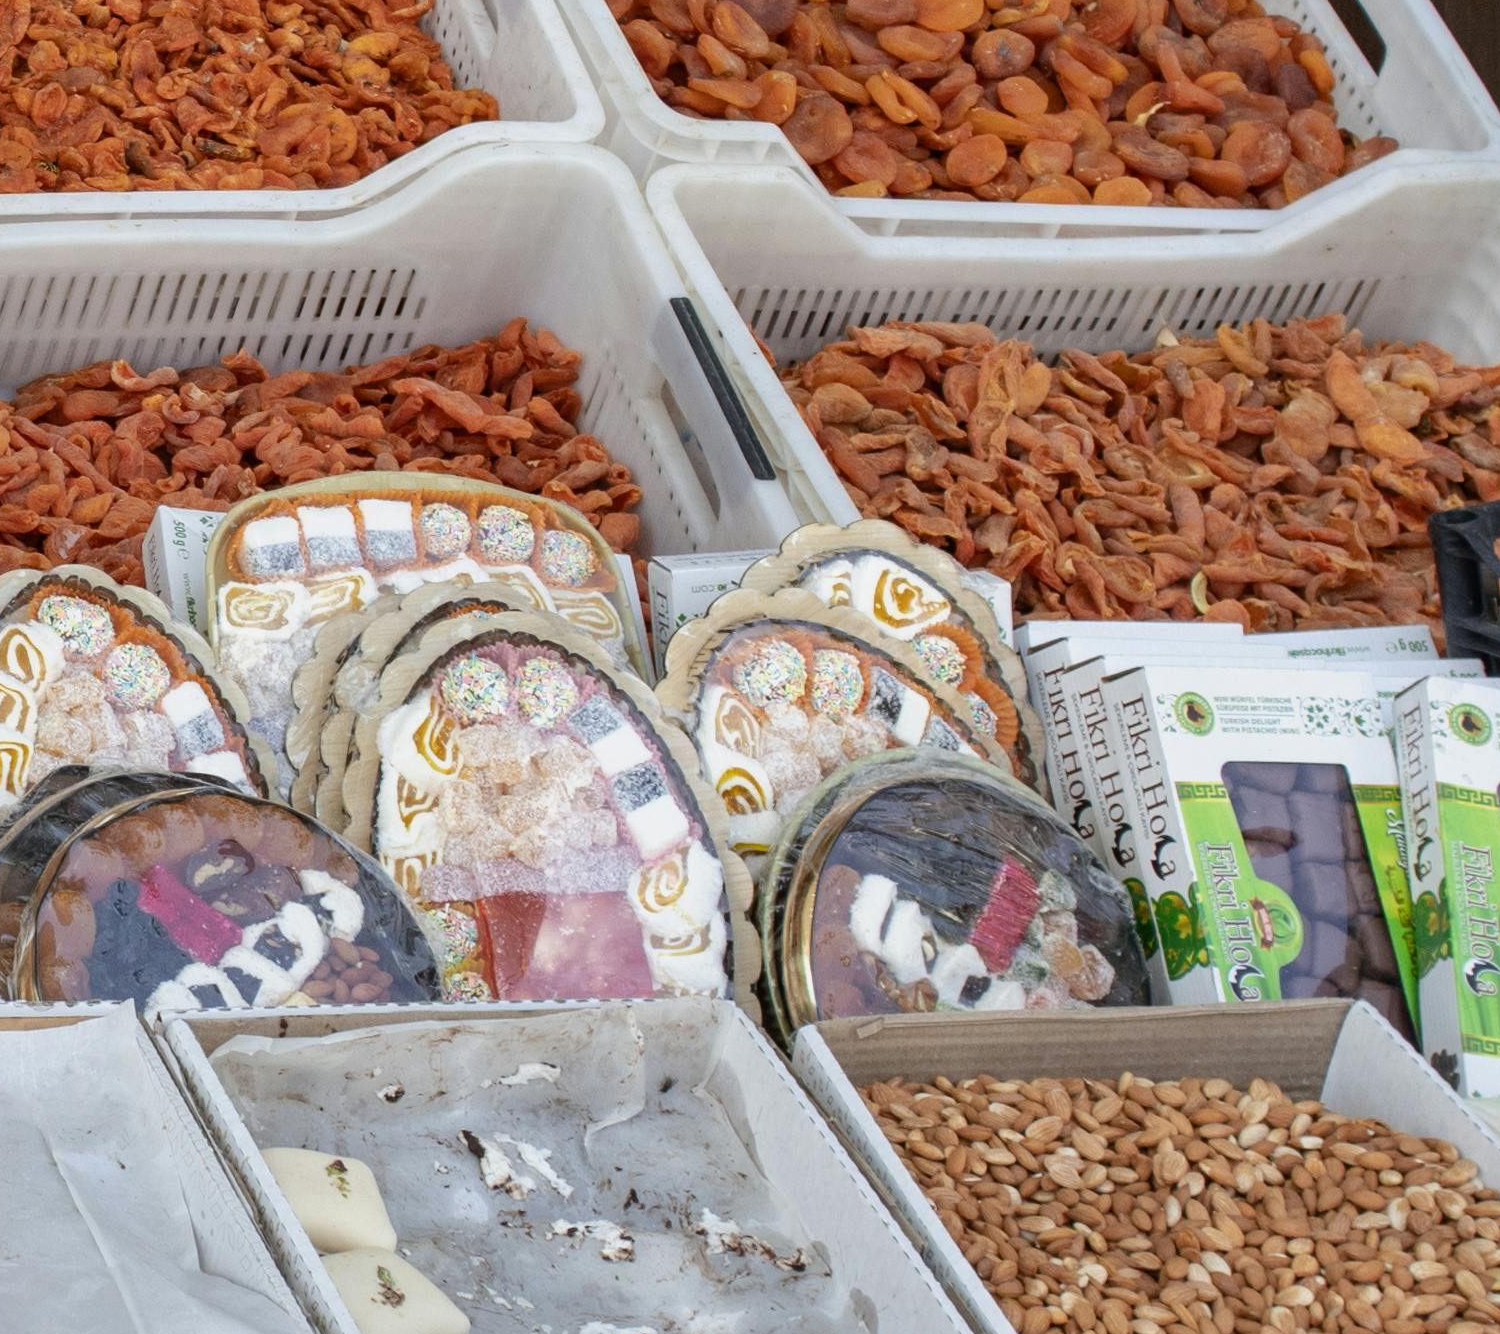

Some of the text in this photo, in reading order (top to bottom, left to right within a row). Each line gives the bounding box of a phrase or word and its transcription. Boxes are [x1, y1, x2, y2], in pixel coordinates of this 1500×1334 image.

[1077, 686, 1116, 763] Fikri
[1120, 695, 1161, 774] Fikri
[1402, 701, 1429, 781] Fikri
[1204, 842, 1248, 912] Fikri
[1462, 844, 1498, 909] Fikri
